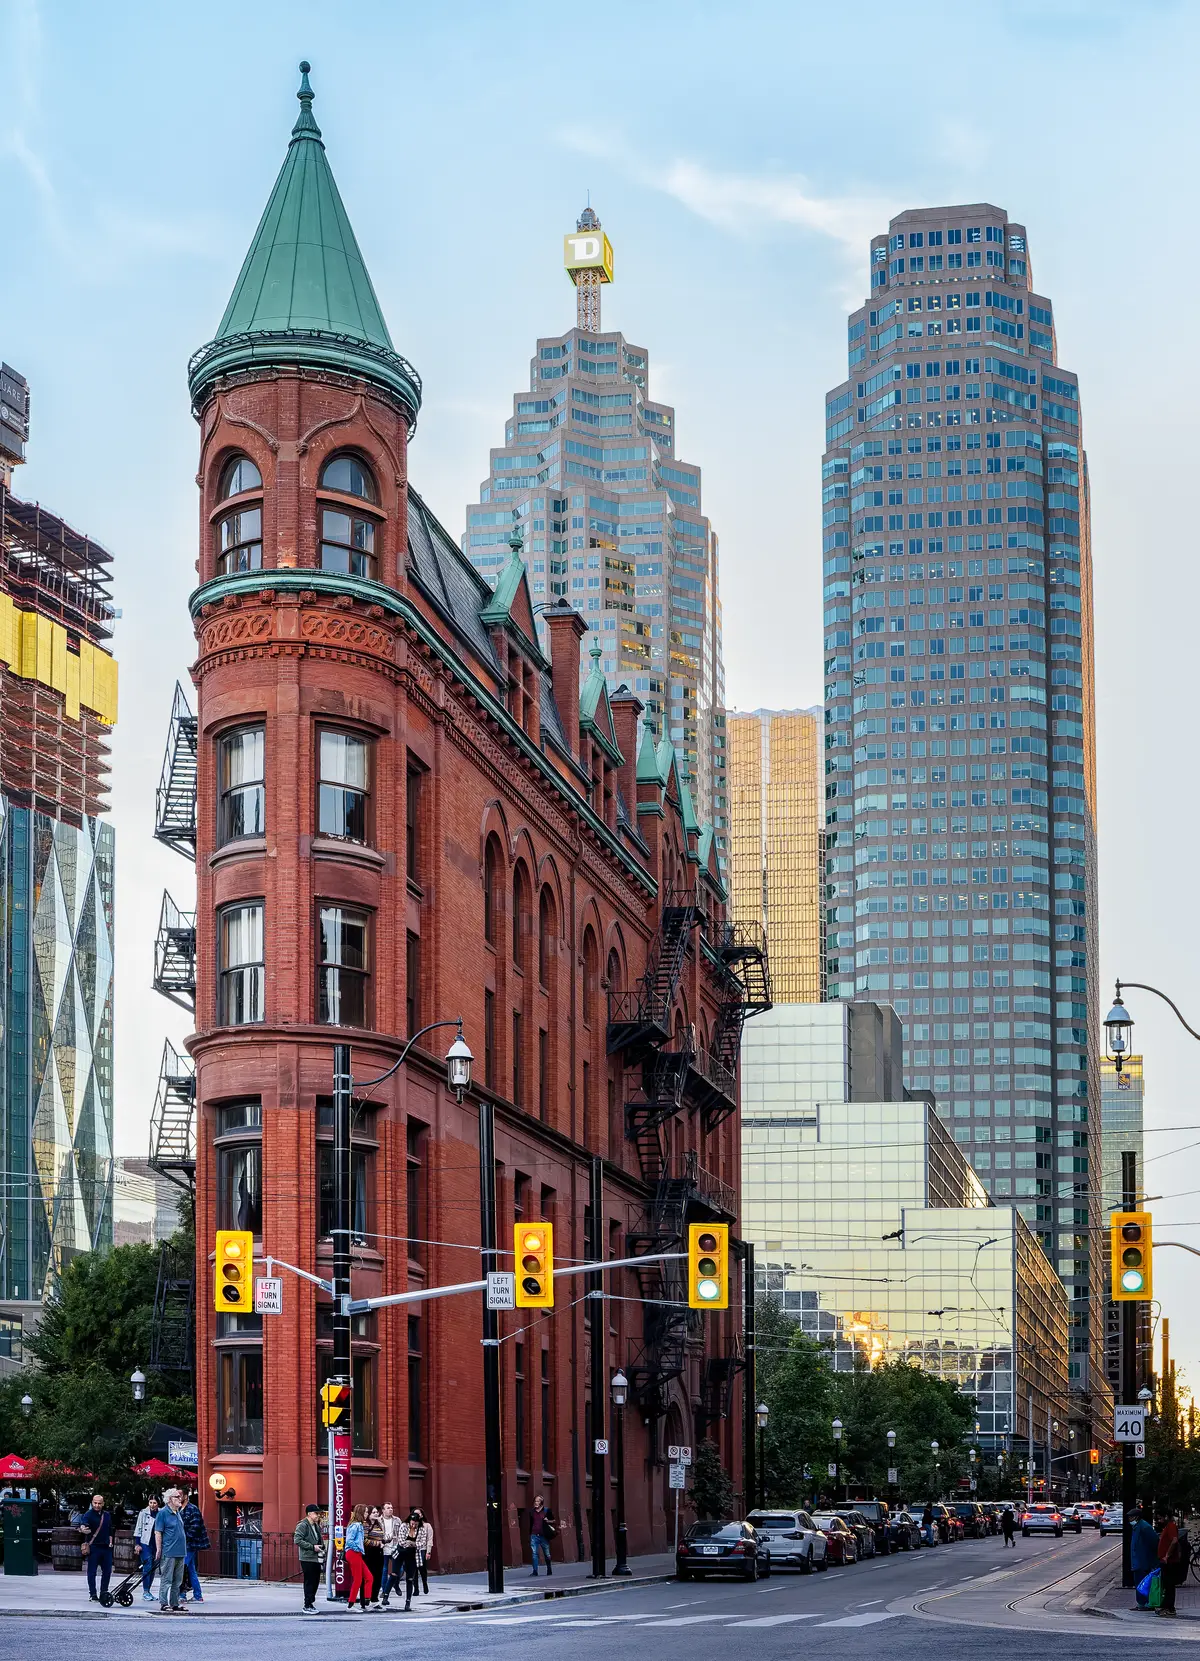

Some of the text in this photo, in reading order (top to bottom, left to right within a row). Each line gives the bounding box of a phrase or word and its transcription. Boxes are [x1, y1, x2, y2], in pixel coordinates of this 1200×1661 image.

[568, 237, 600, 261] TD
[493, 1277, 509, 1285] LEFT
[261, 1282, 277, 1290] LEFT
[492, 1286, 510, 1295] TURN
[260, 1291, 277, 1300] TURN
[489, 1296, 512, 1305] SIGNAL
[257, 1301, 280, 1310] SIGNAL
[1117, 1420, 1142, 1436] 40
[336, 1473, 344, 1523] TORONTO
[335, 1559, 345, 1584] OLD
